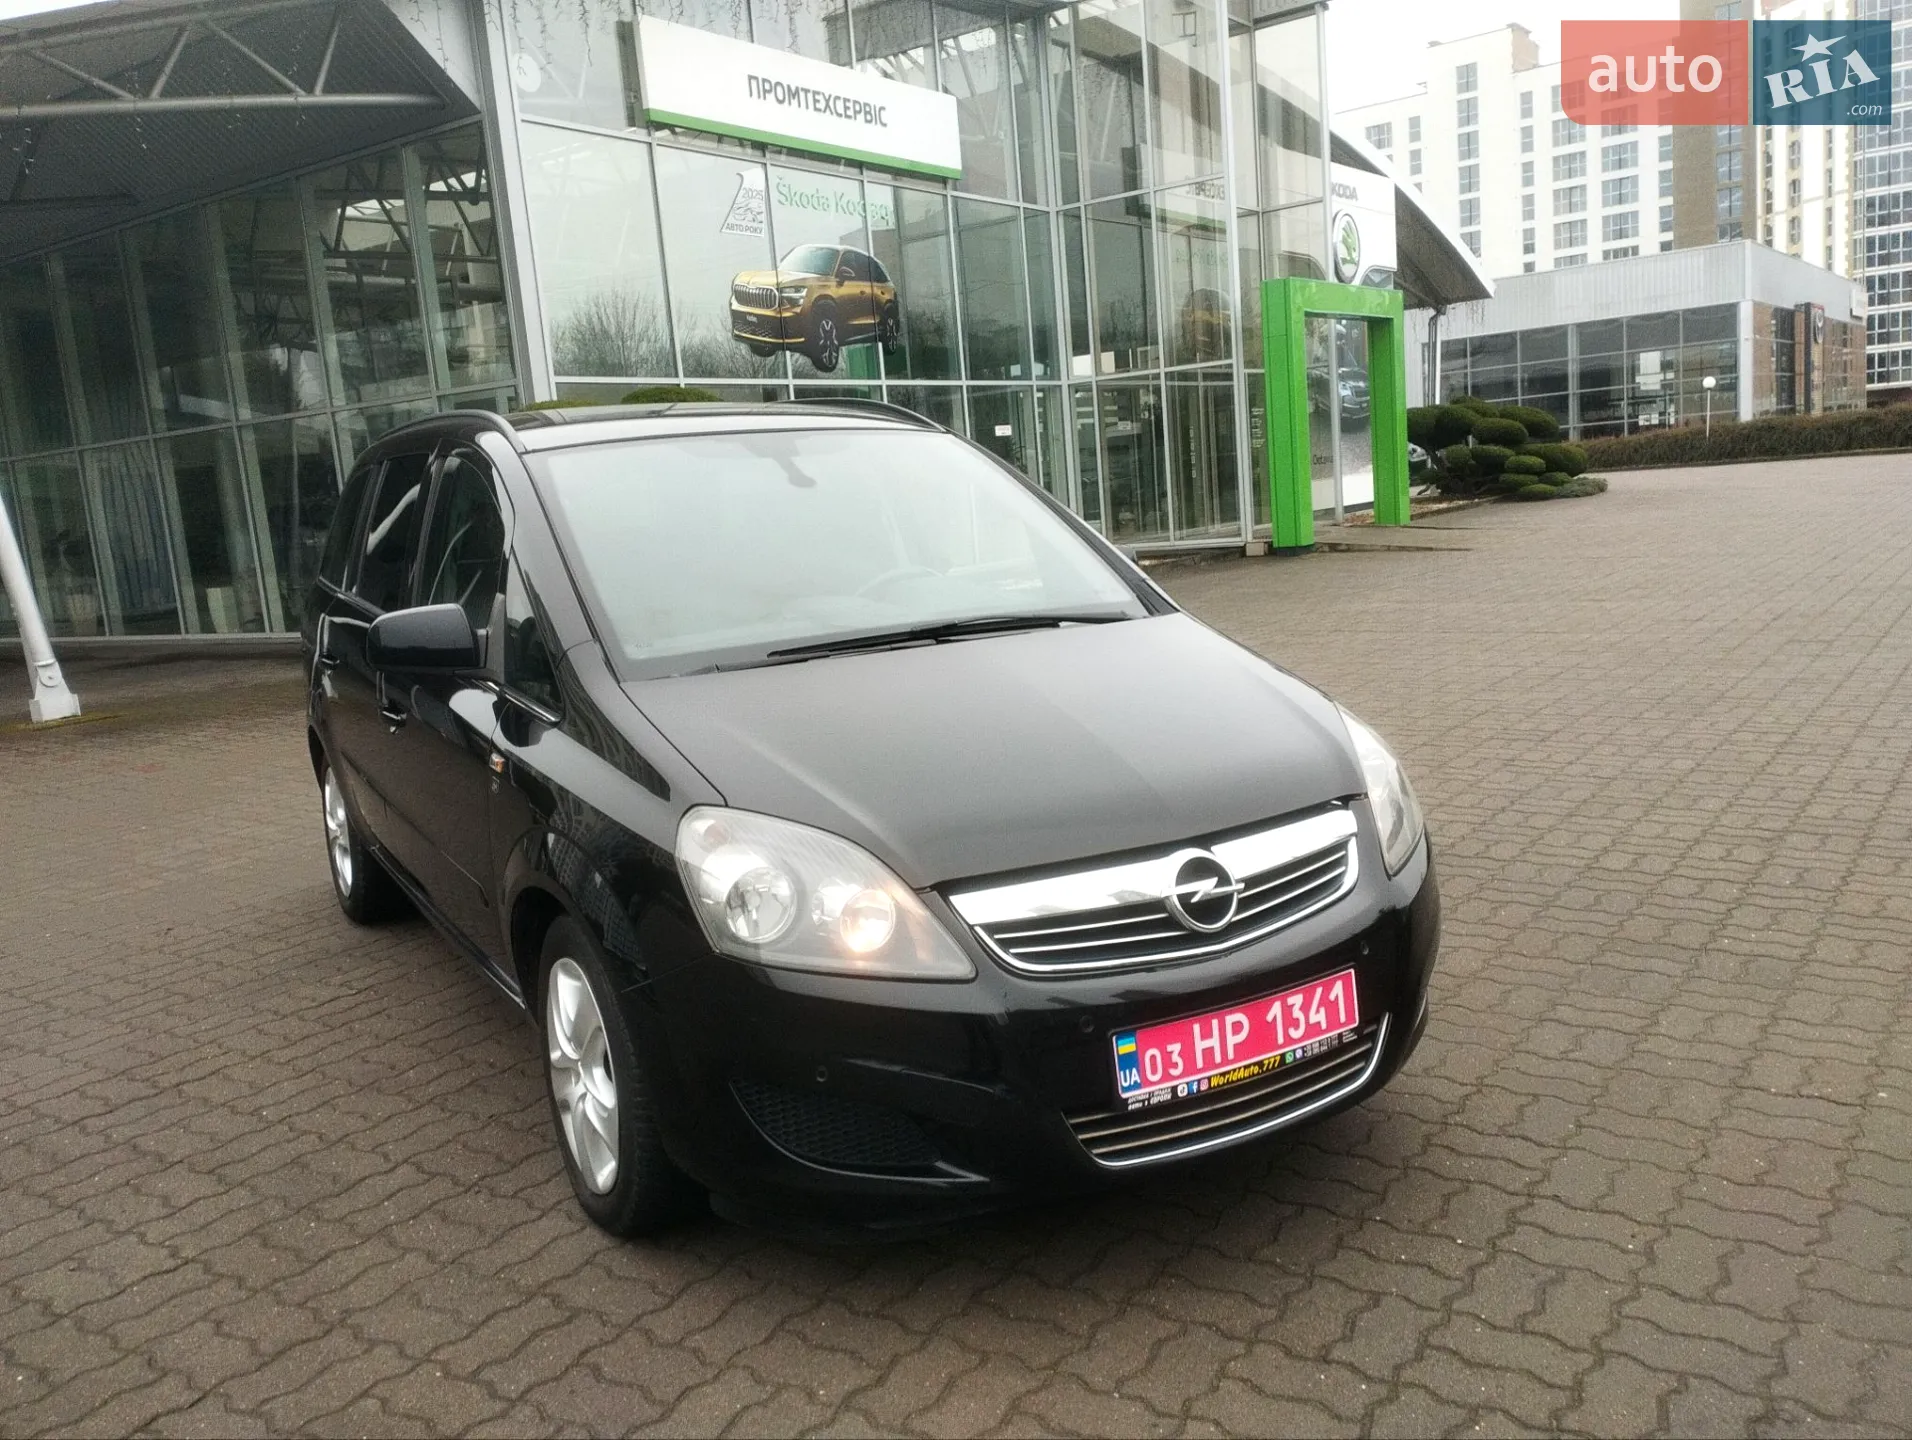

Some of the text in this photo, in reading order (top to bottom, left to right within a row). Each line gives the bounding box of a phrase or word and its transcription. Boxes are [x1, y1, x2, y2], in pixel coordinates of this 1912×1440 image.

[747, 74, 888, 127] ПРОМТЕХСЕРВІС
[776, 175, 890, 227] Škoda Koaq
[1331, 181, 1359, 202] KODA
[725, 222, 763, 235] АВТО РОКУ
[1120, 1067, 1140, 1087] UA
[1144, 1042, 1184, 1082] 03
[1193, 1012, 1250, 1069] HP
[1266, 979, 1346, 1046] 1341
[1211, 1055, 1281, 1088] WorldAuto.777
